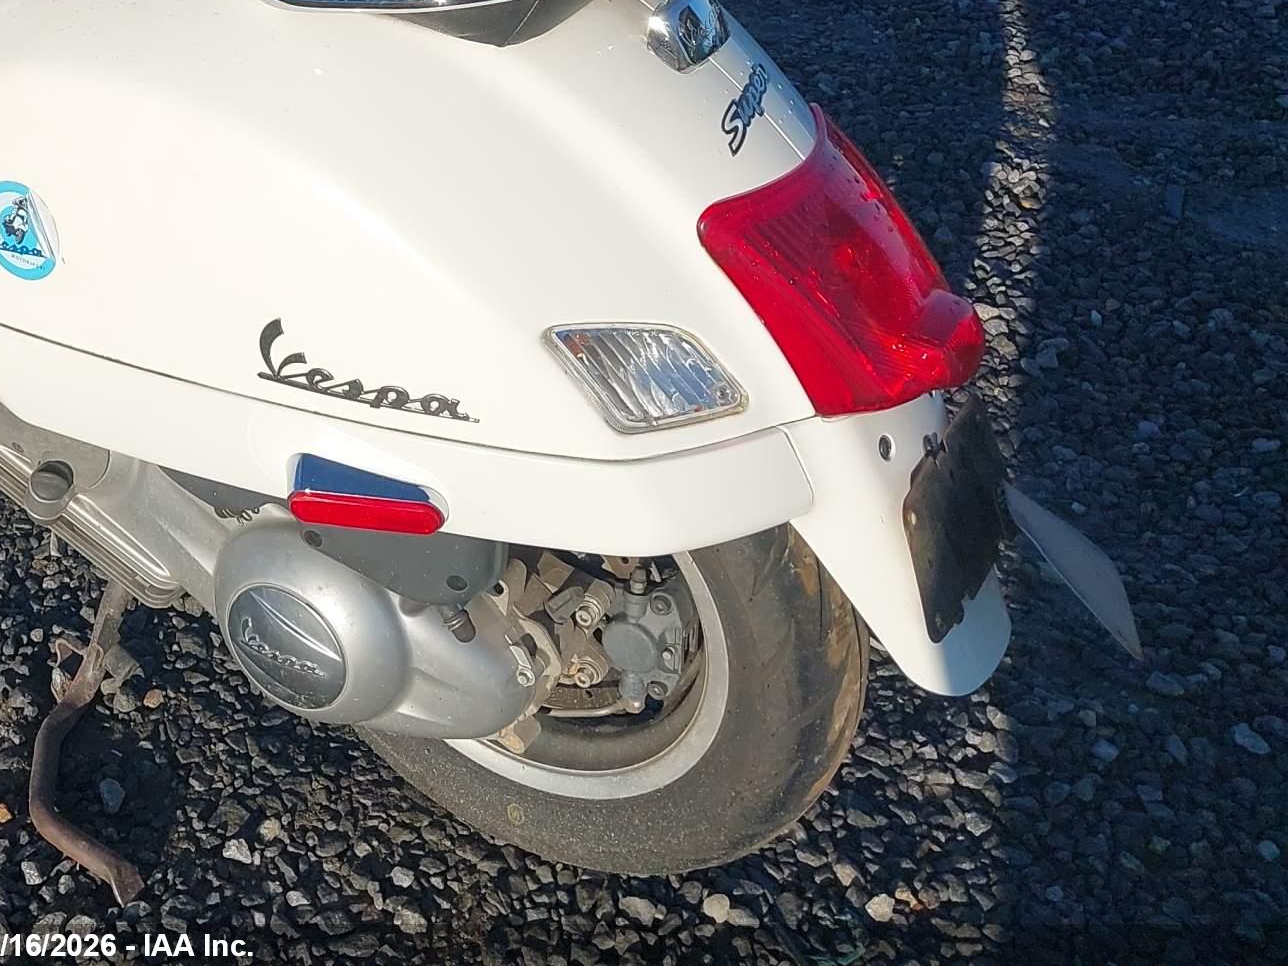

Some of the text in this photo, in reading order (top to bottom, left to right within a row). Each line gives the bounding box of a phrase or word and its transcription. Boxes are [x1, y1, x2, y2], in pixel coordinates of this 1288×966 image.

[721, 63, 769, 156] Super
[257, 317, 480, 424] Vespa
[240, 617, 326, 677] Vespa
